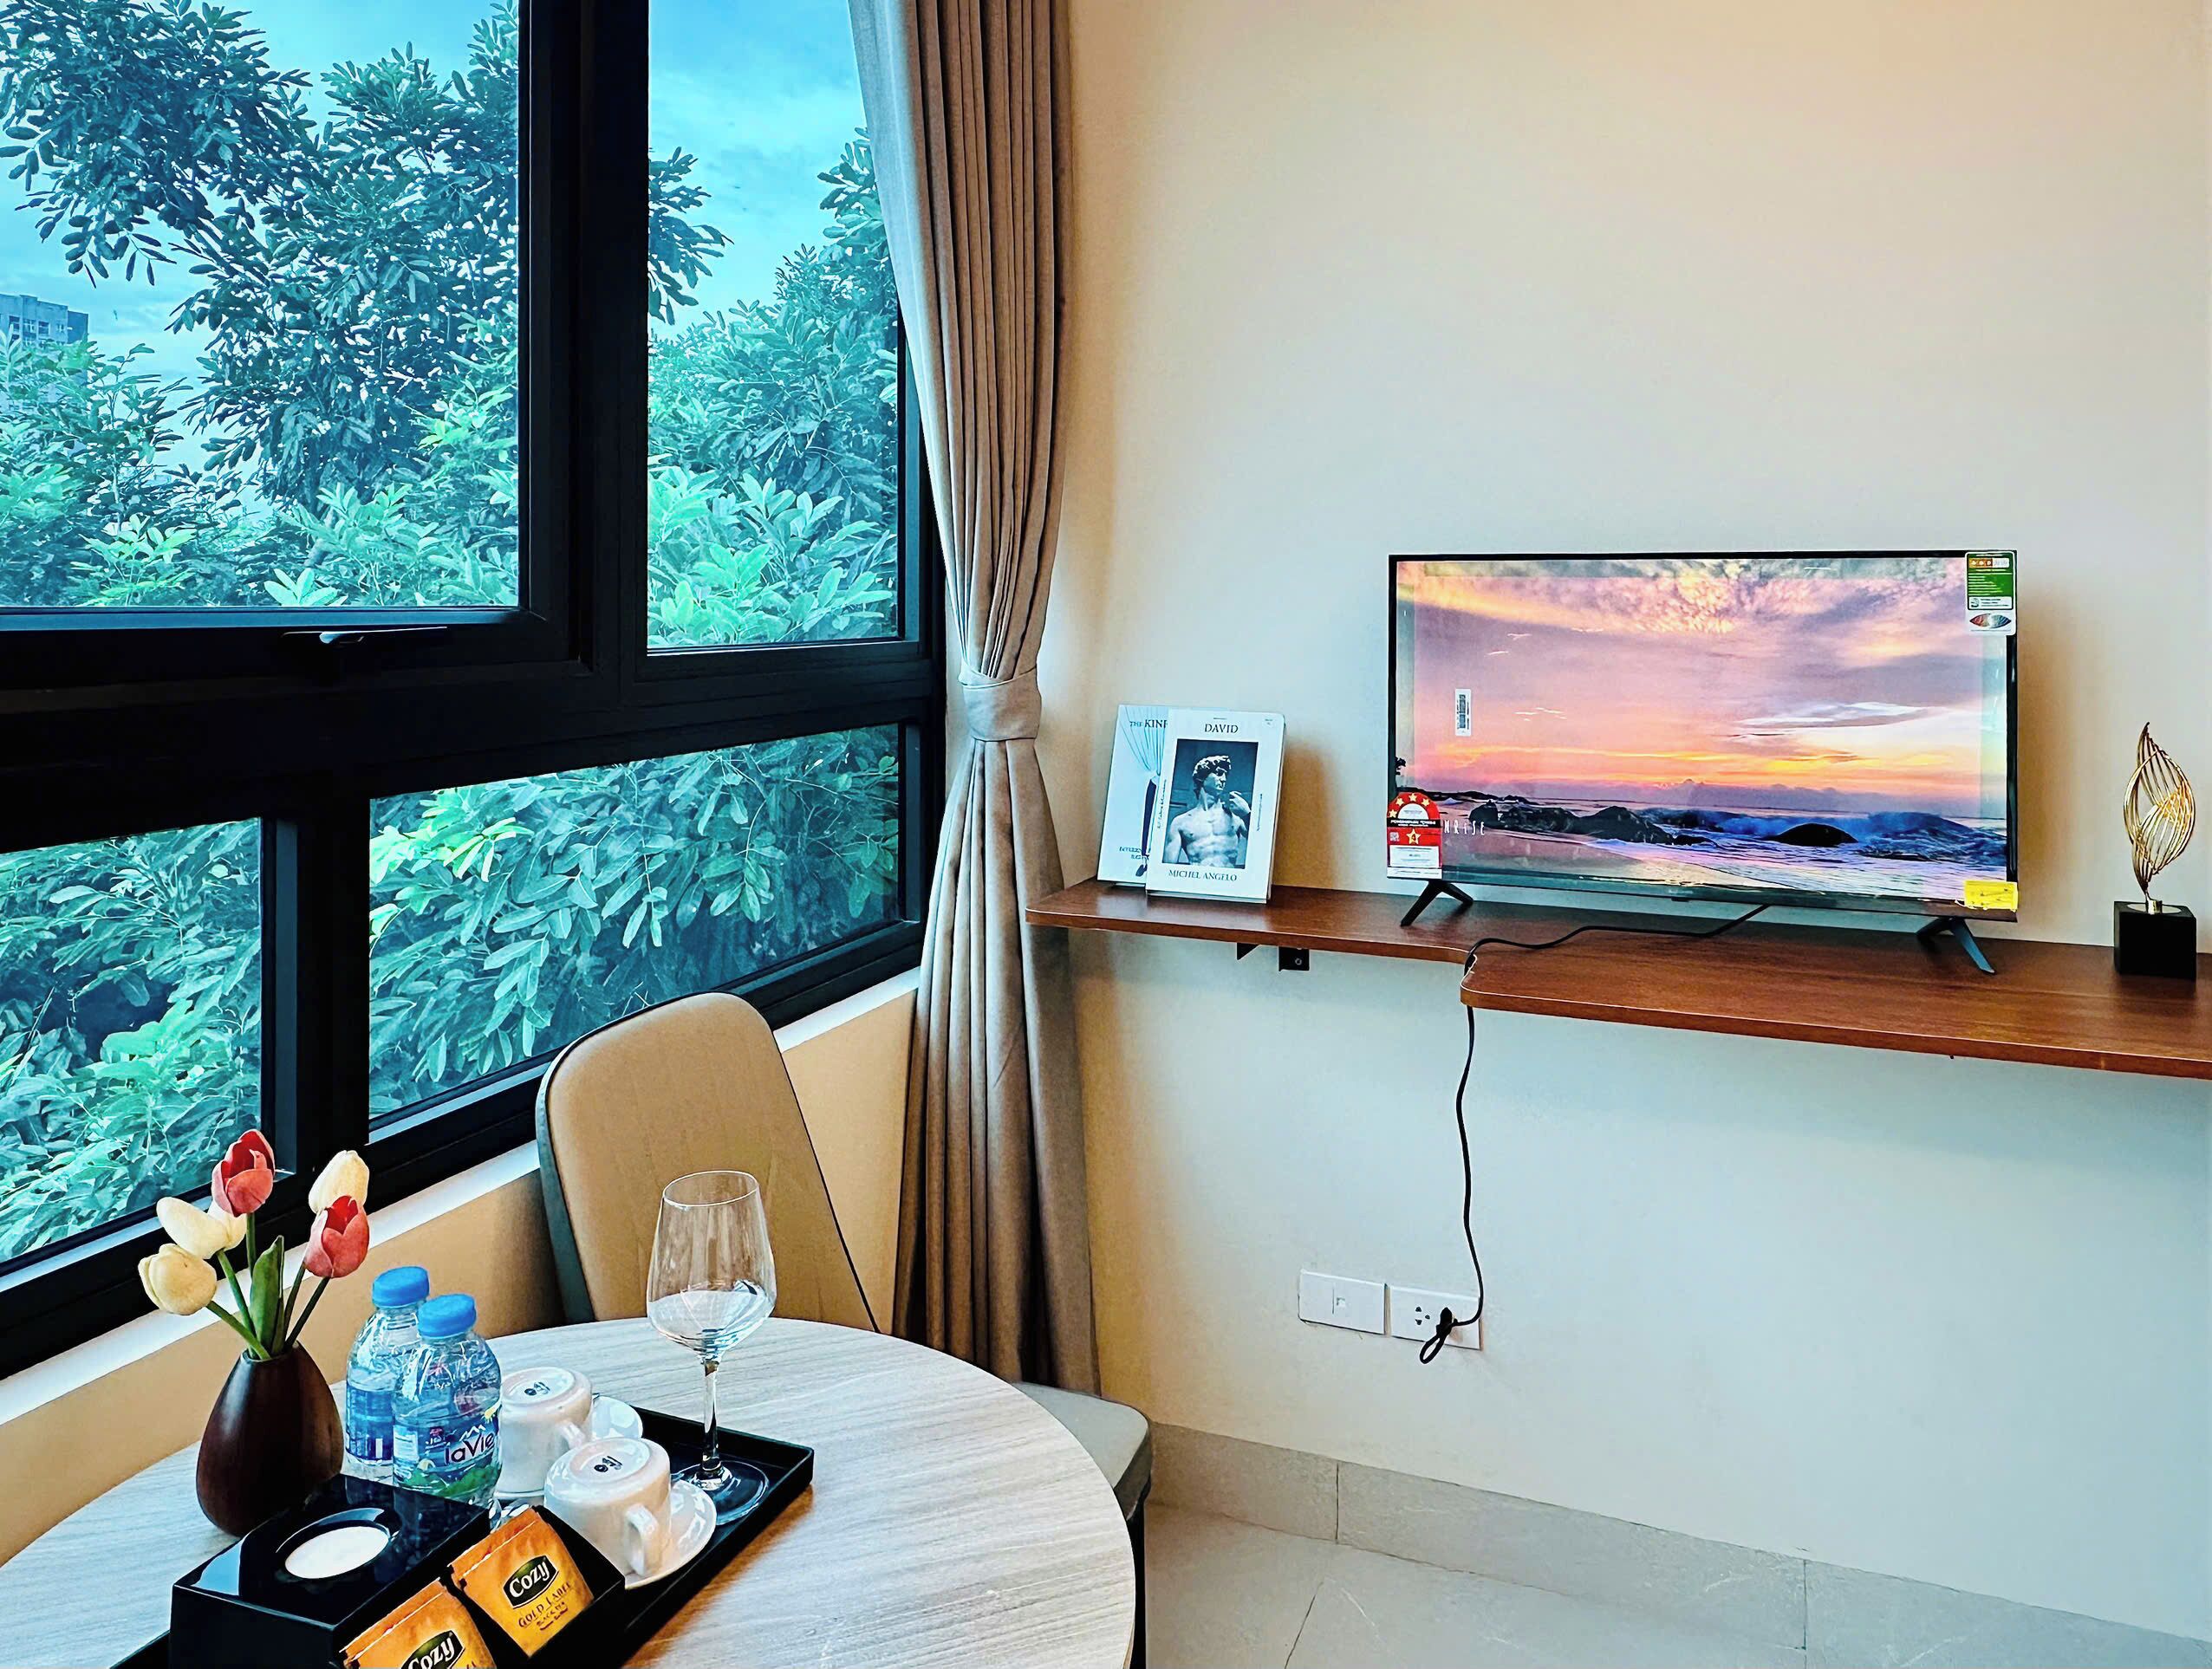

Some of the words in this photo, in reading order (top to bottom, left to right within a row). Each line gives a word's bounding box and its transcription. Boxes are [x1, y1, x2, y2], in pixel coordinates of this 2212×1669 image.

[1204, 723, 1239, 735] DAVID
[1168, 869, 1201, 880] MICHEL
[1202, 872, 1238, 882] ANGELO
[509, 1561, 550, 1598] Cozy
